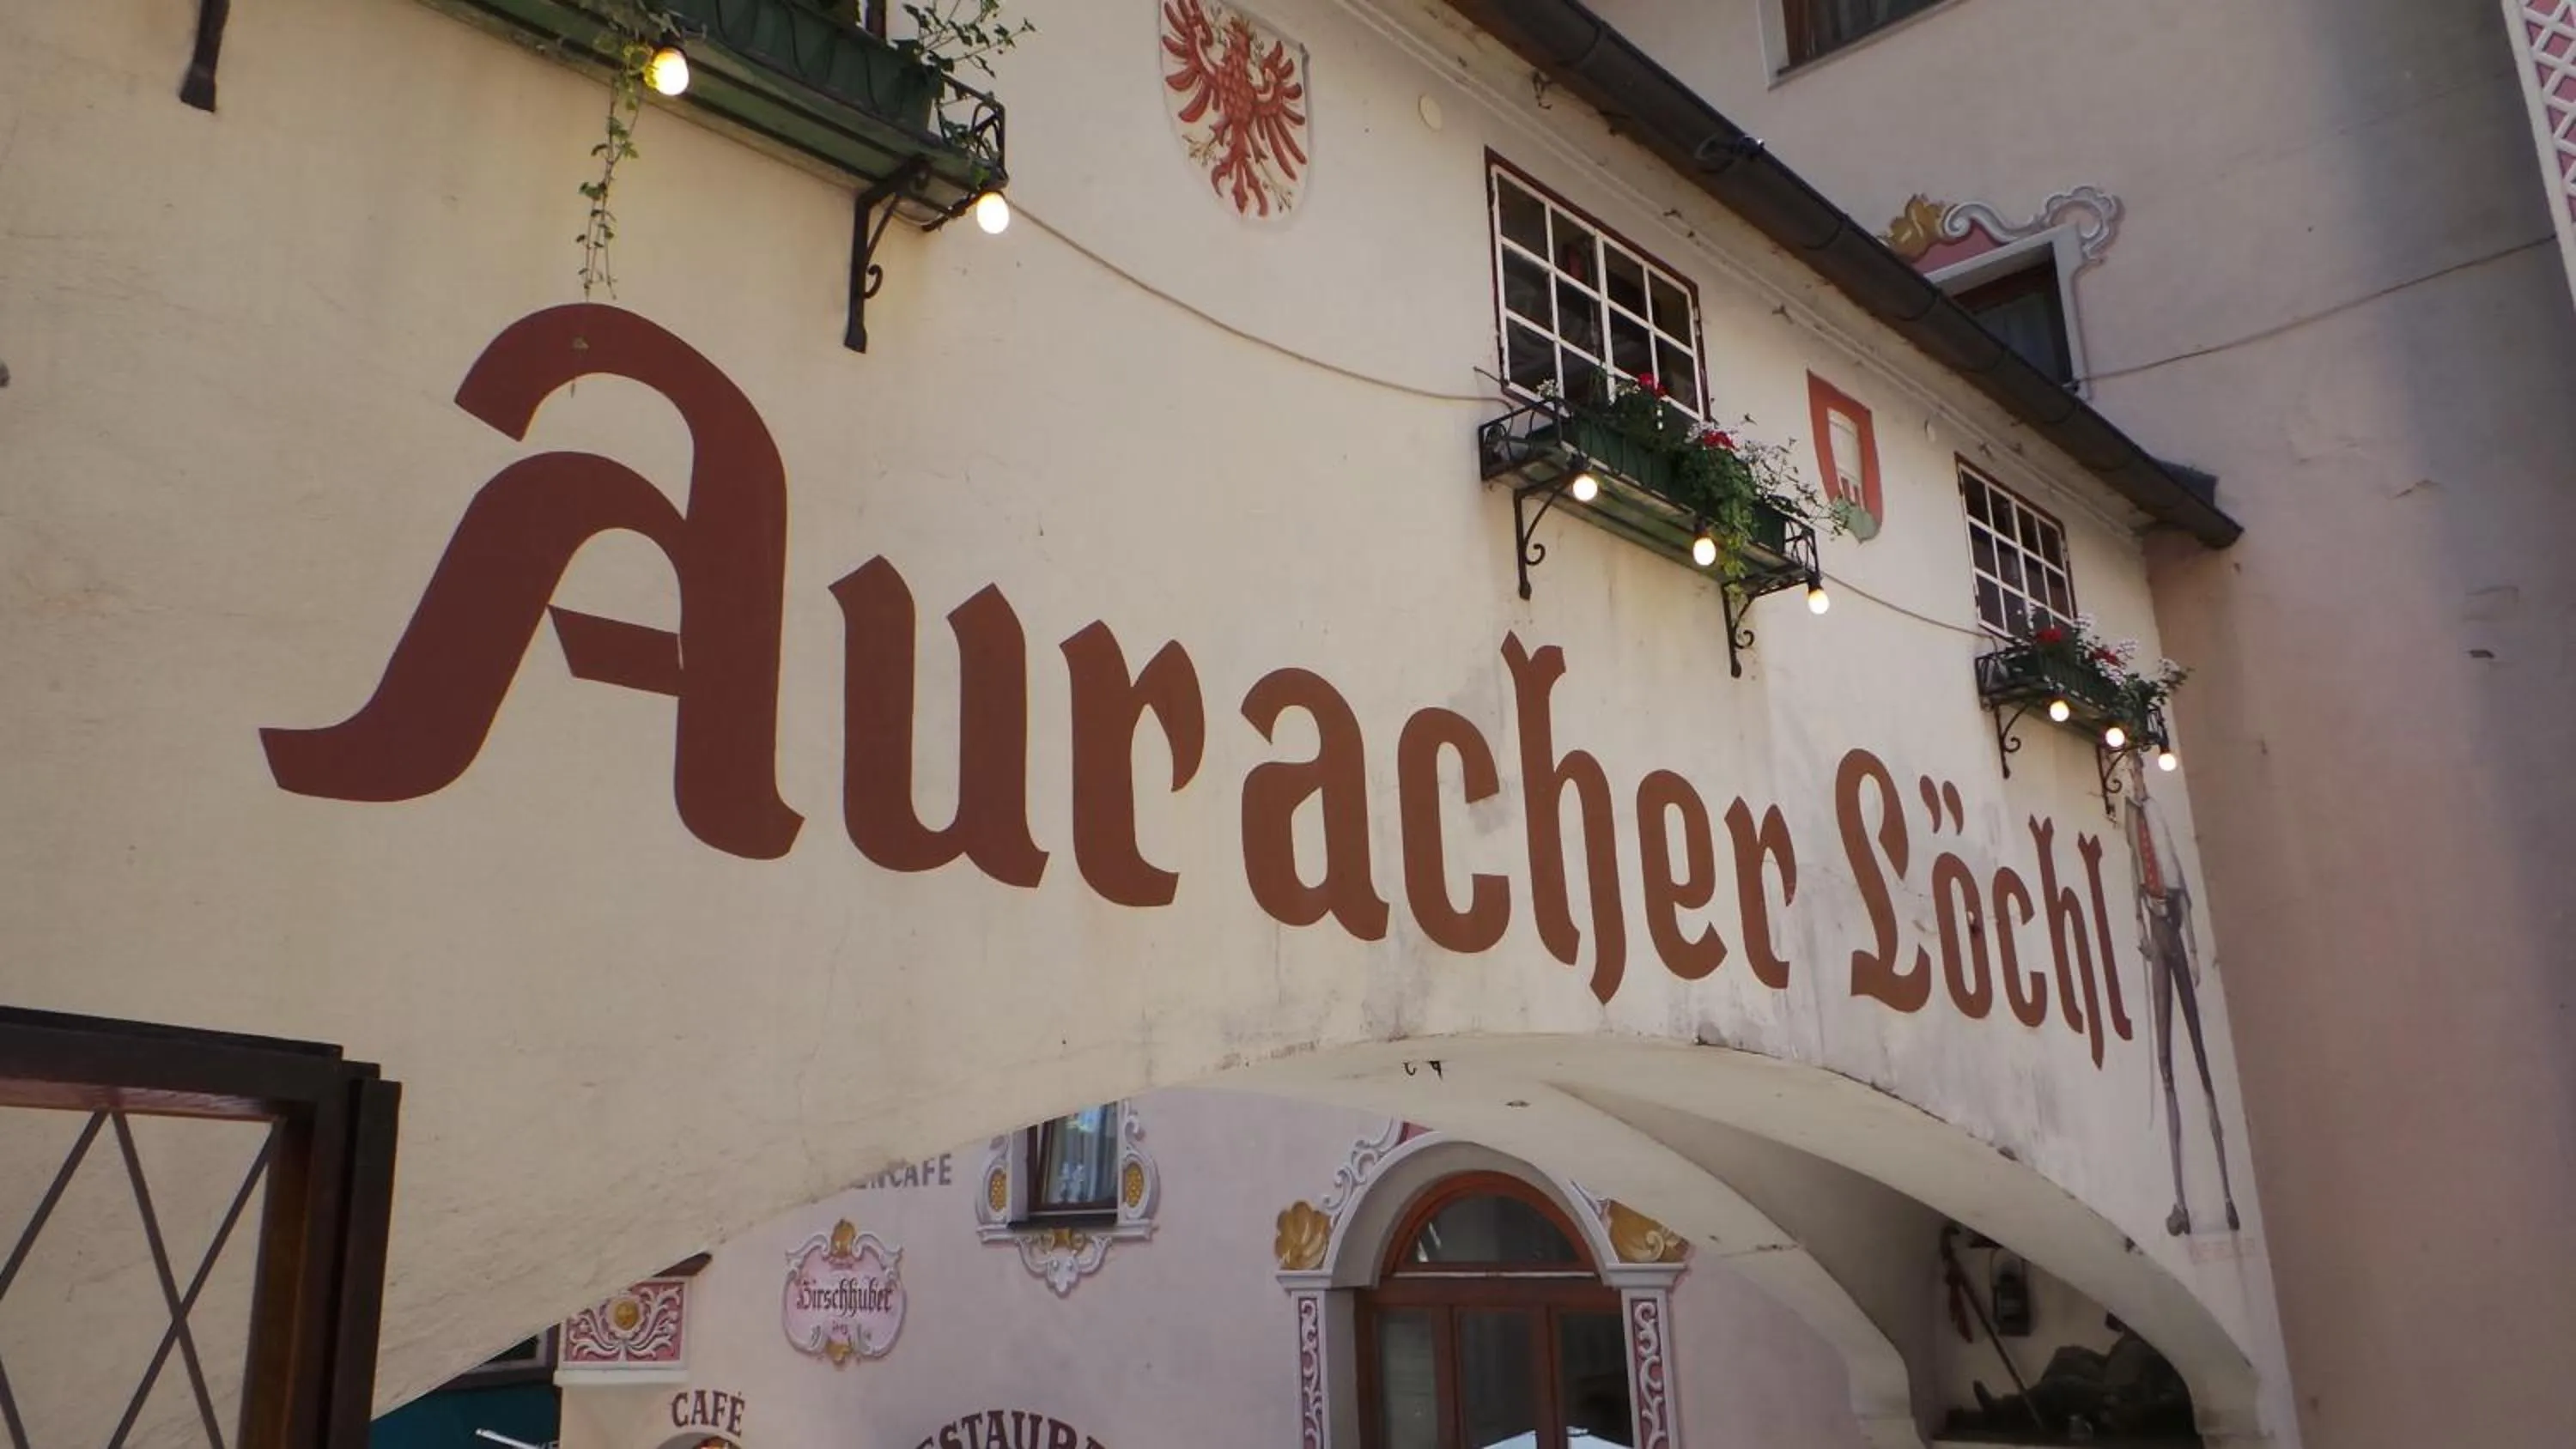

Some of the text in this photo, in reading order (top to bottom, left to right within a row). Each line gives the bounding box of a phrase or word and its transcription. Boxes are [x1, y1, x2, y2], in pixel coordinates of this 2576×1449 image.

[259, 303, 2133, 1070] Auracher Löchl
[914, 1409, 1109, 1449] STAUR
